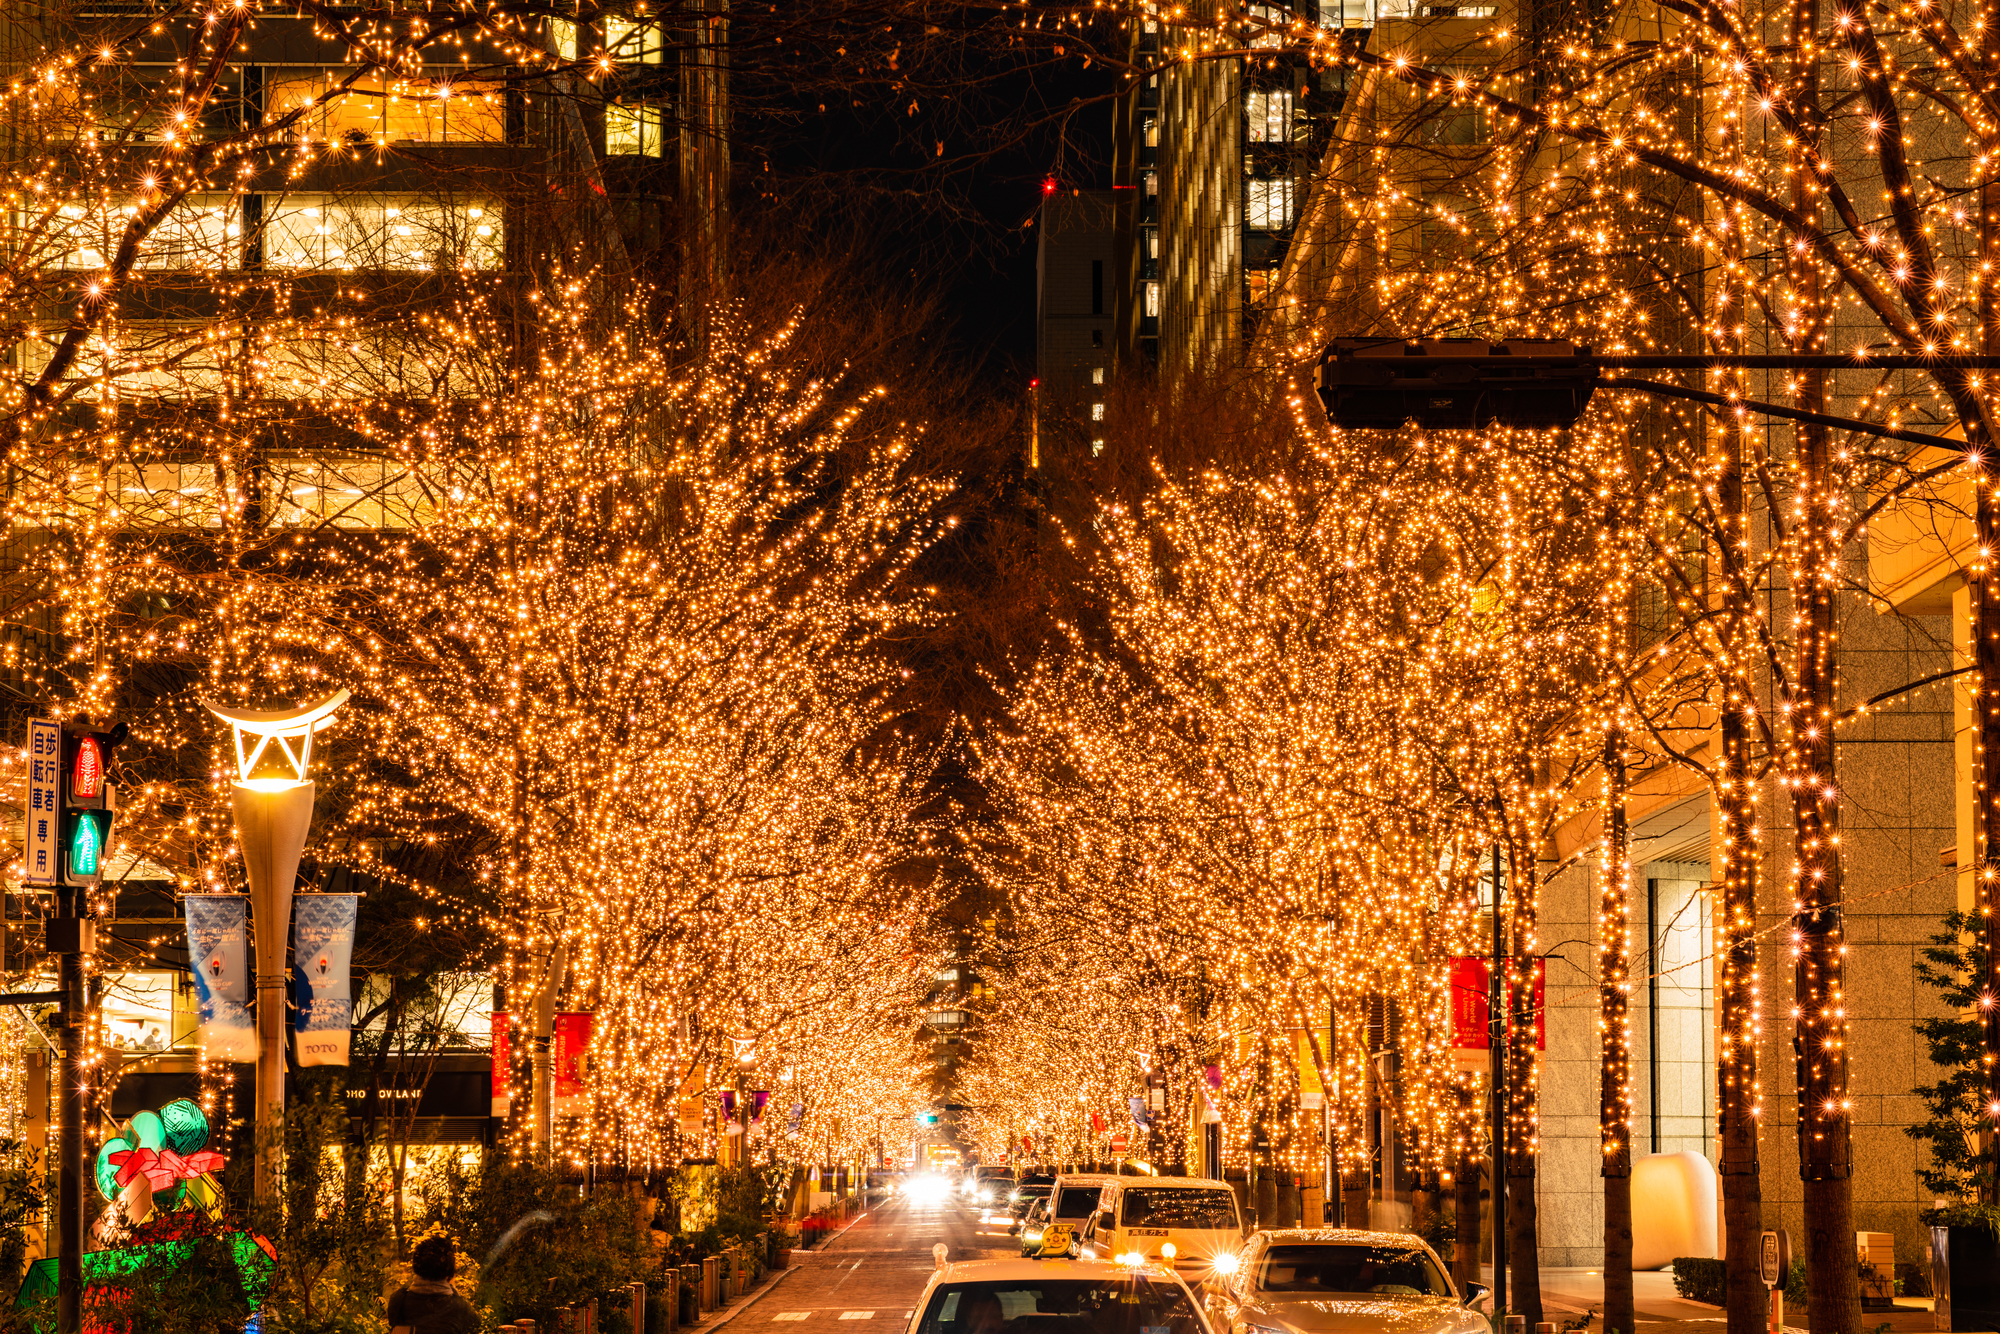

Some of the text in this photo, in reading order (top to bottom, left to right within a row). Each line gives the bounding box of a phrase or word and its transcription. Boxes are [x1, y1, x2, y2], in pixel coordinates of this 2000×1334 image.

[32, 730, 44, 811] 自転車
[44, 731, 57, 812] 歩行者
[36, 819, 48, 873] 専用
[301, 1006, 346, 1016] ワールドカップ
[310, 998, 336, 1007] ラグビー
[310, 1015, 330, 1023] 2019
[305, 1043, 338, 1054] TOTO
[494, 1035, 502, 1078] #RWC2019
[558, 1034, 566, 1078] #RWC2019
